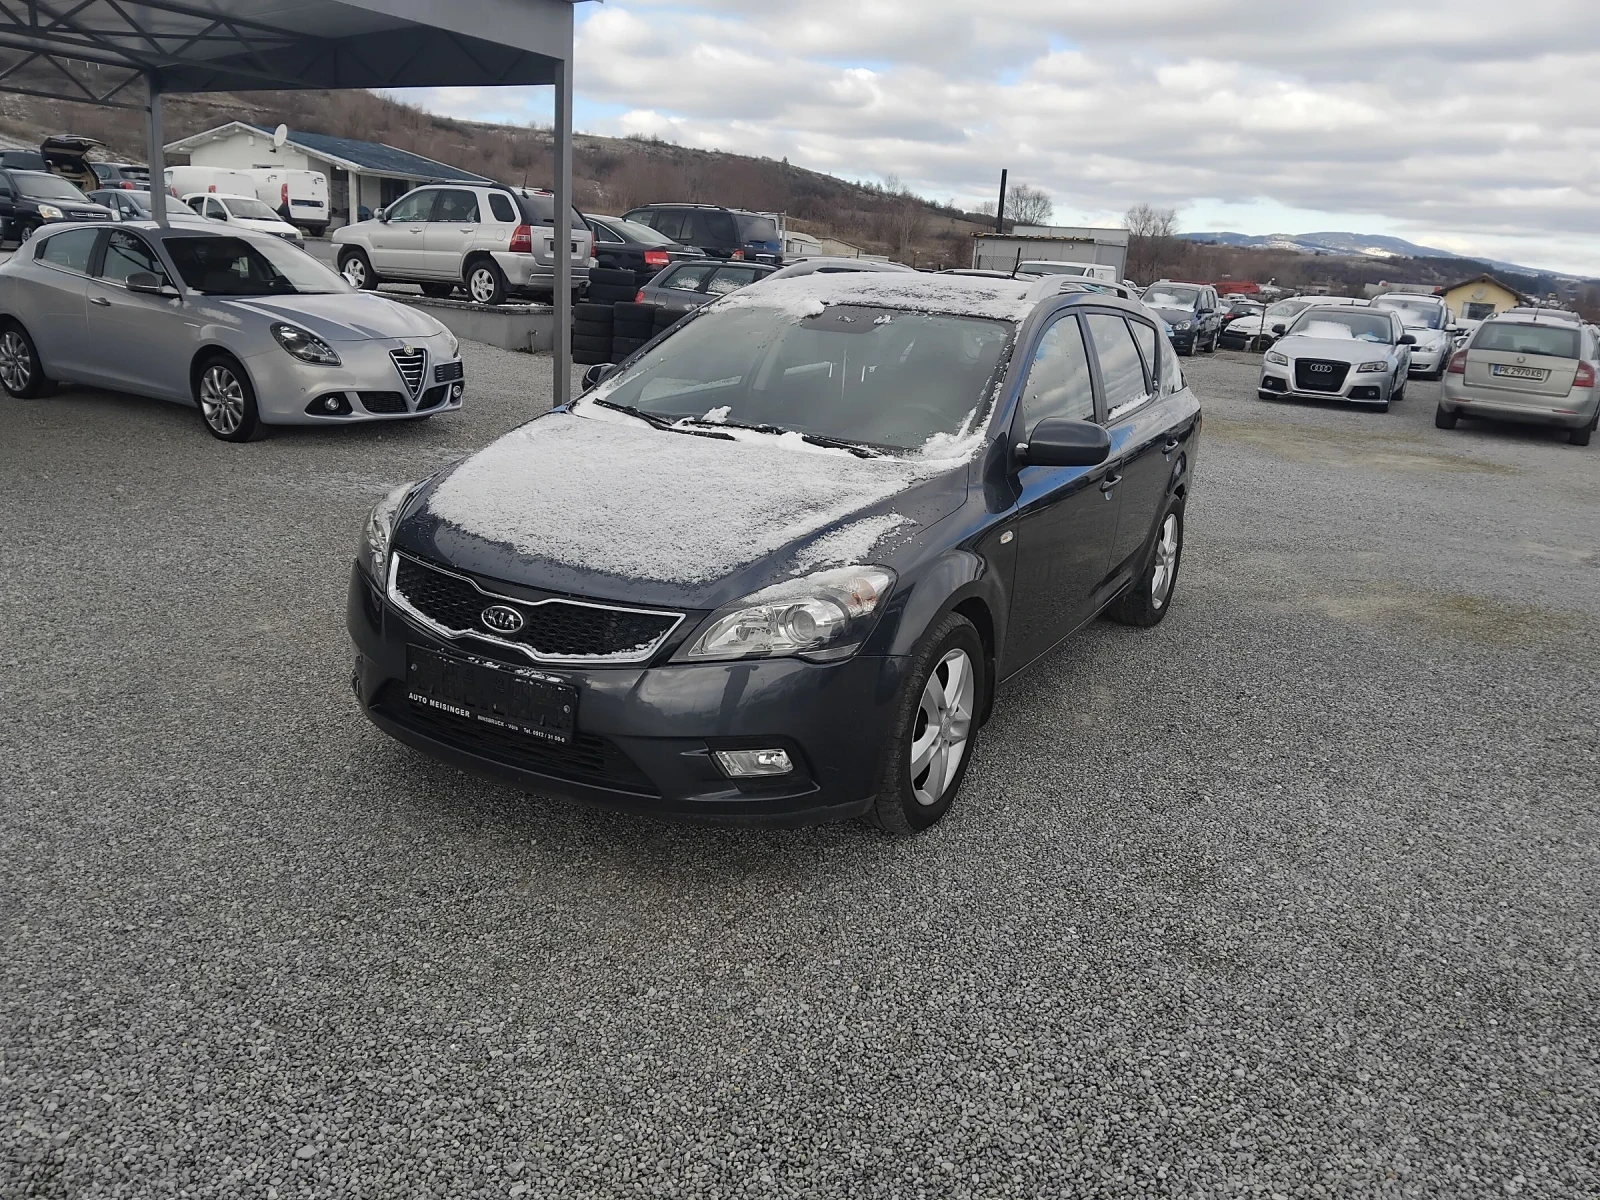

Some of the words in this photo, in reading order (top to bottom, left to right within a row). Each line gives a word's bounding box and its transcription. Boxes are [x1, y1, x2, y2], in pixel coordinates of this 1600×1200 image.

[1510, 368, 1530, 376] 2970
[488, 609, 515, 630] KIA
[408, 692, 428, 704] AUTO
[429, 699, 470, 718] MEISINGER
